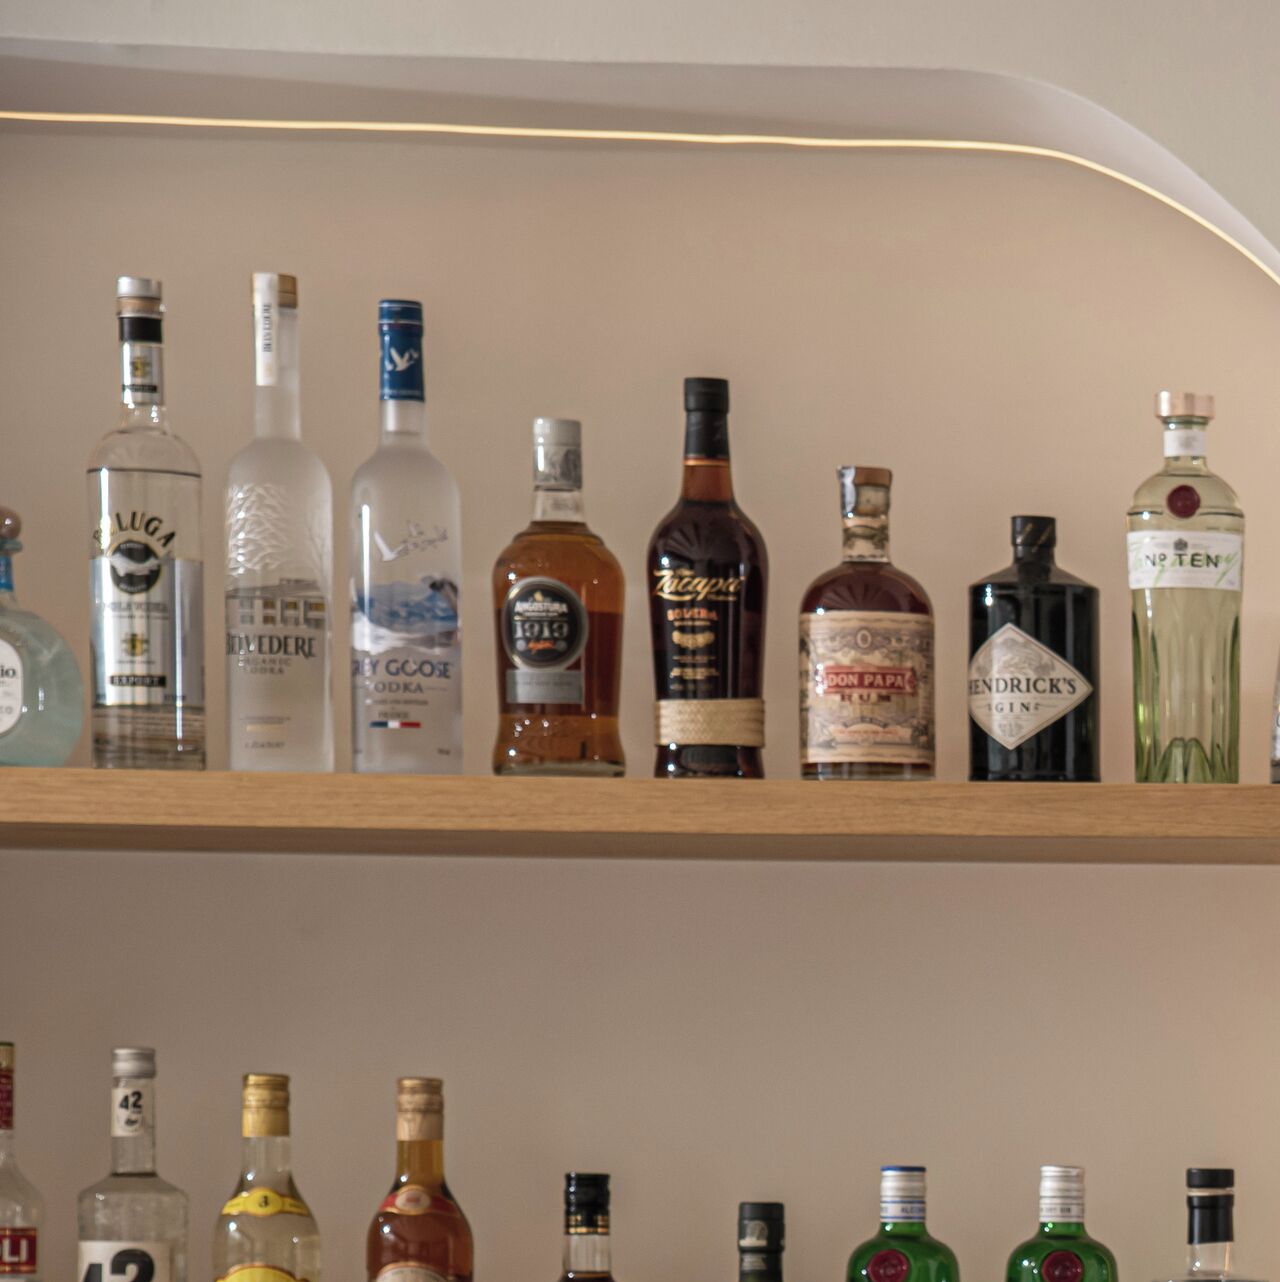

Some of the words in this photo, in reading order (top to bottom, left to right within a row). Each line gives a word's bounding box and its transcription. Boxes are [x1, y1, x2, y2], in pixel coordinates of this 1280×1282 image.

[93, 511, 176, 548] BLUGA
[1173, 552, 1220, 568] TEN
[513, 621, 568, 638] 1919
[385, 659, 450, 678] GOOSE
[828, 674, 859, 686] DON
[864, 674, 903, 687] PAPA
[995, 702, 1030, 713] GIN
[119, 1091, 142, 1110] 42
